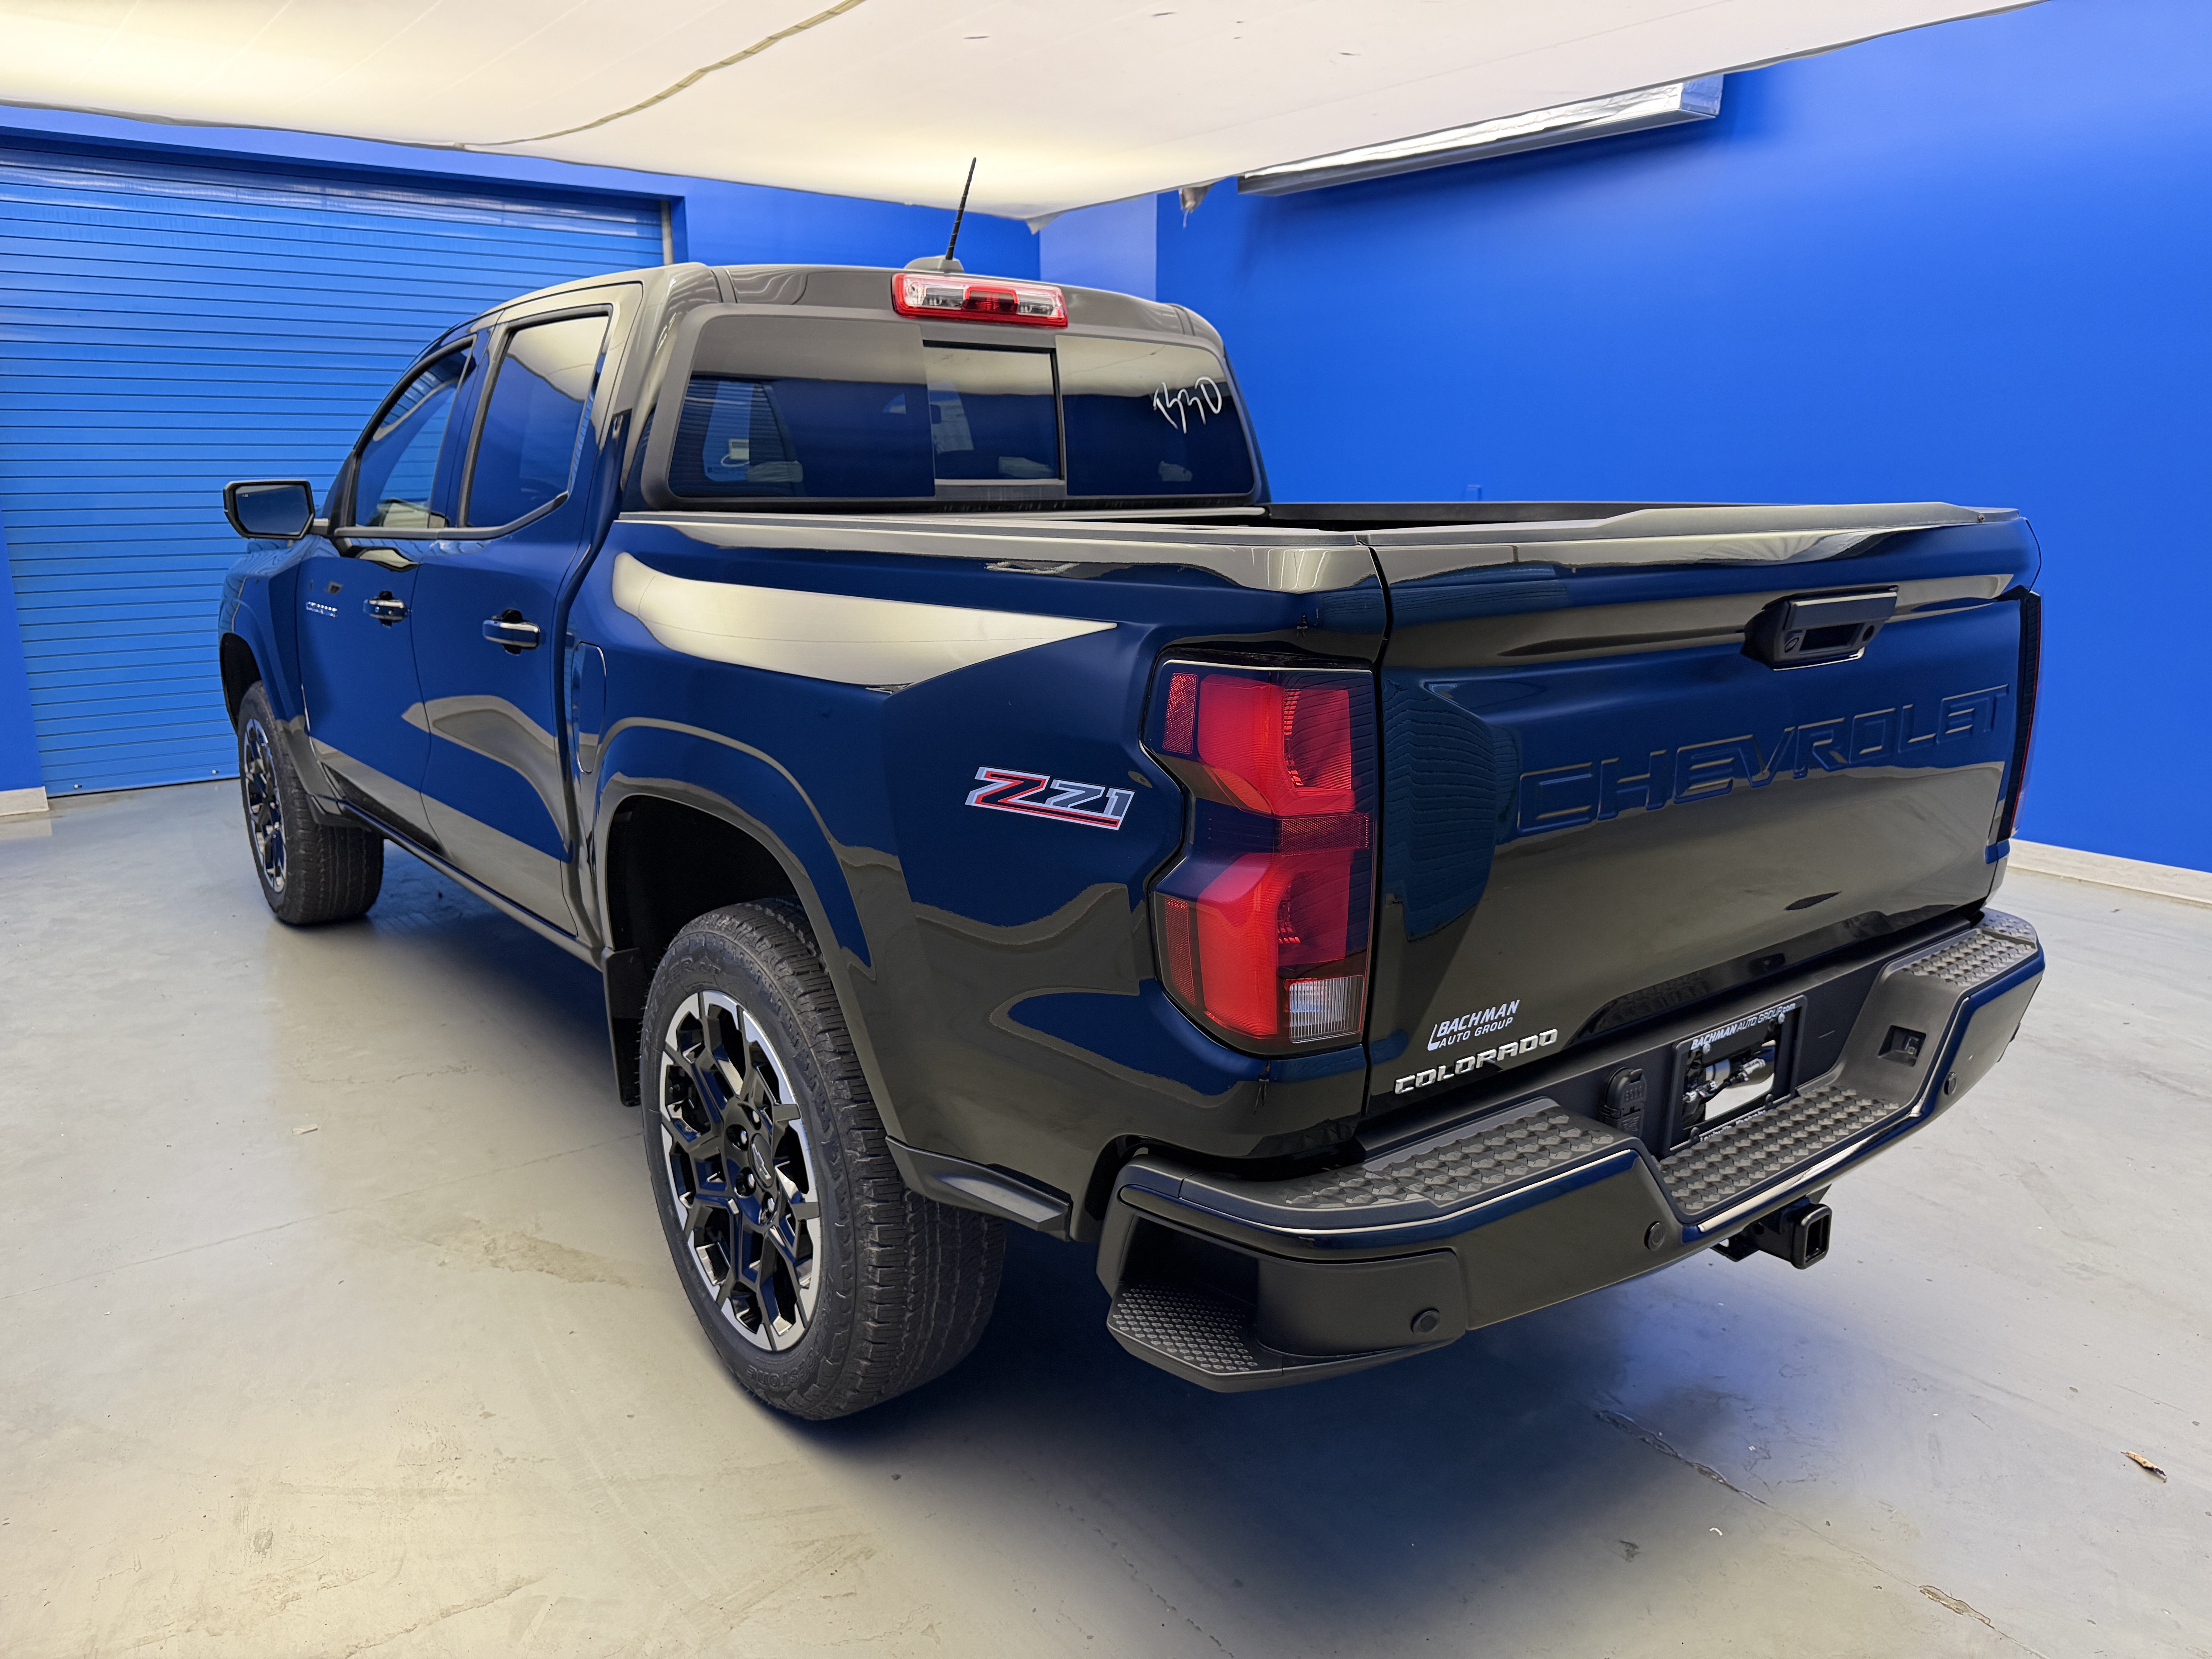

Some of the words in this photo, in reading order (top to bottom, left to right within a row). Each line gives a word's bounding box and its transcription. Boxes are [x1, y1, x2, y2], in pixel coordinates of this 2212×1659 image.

[1518, 684, 2008, 835] CHEVROLET
[965, 765, 1136, 831] Z71
[1437, 999, 1520, 1037] BACHMAN
[1438, 1030, 1471, 1048] AUTO
[1474, 1017, 1513, 1037] GROUP
[1690, 1024, 1738, 1050] BACHMAN
[1736, 1017, 1758, 1032] AUTO
[1395, 1029, 1558, 1094] COLORADO
